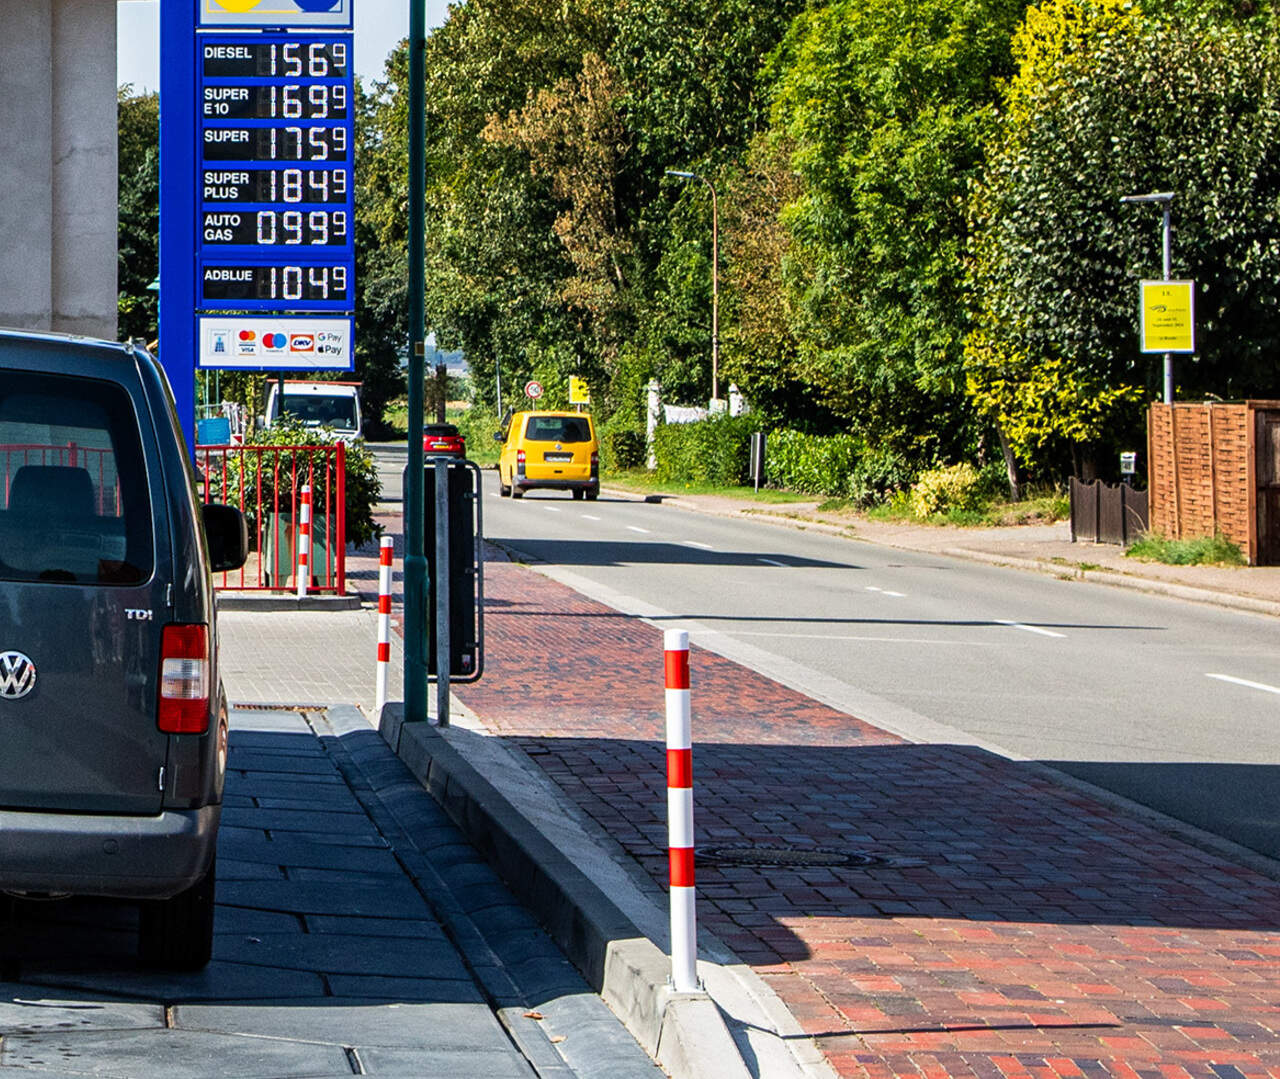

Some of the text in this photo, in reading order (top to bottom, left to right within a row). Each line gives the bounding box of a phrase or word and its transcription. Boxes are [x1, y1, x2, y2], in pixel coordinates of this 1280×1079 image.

[204, 47, 252, 58] DIESEL
[204, 88, 249, 100] SUPER
[204, 130, 249, 142] SUPER
[204, 172, 249, 184] SUPER
[204, 187, 239, 198] PLUS
[204, 214, 241, 226] AUTO
[204, 229, 233, 241] GAS
[204, 270, 253, 281] ADBLUE
[327, 333, 342, 342] Pay
[325, 346, 342, 355] Pay
[125, 608, 153, 621] TDI
